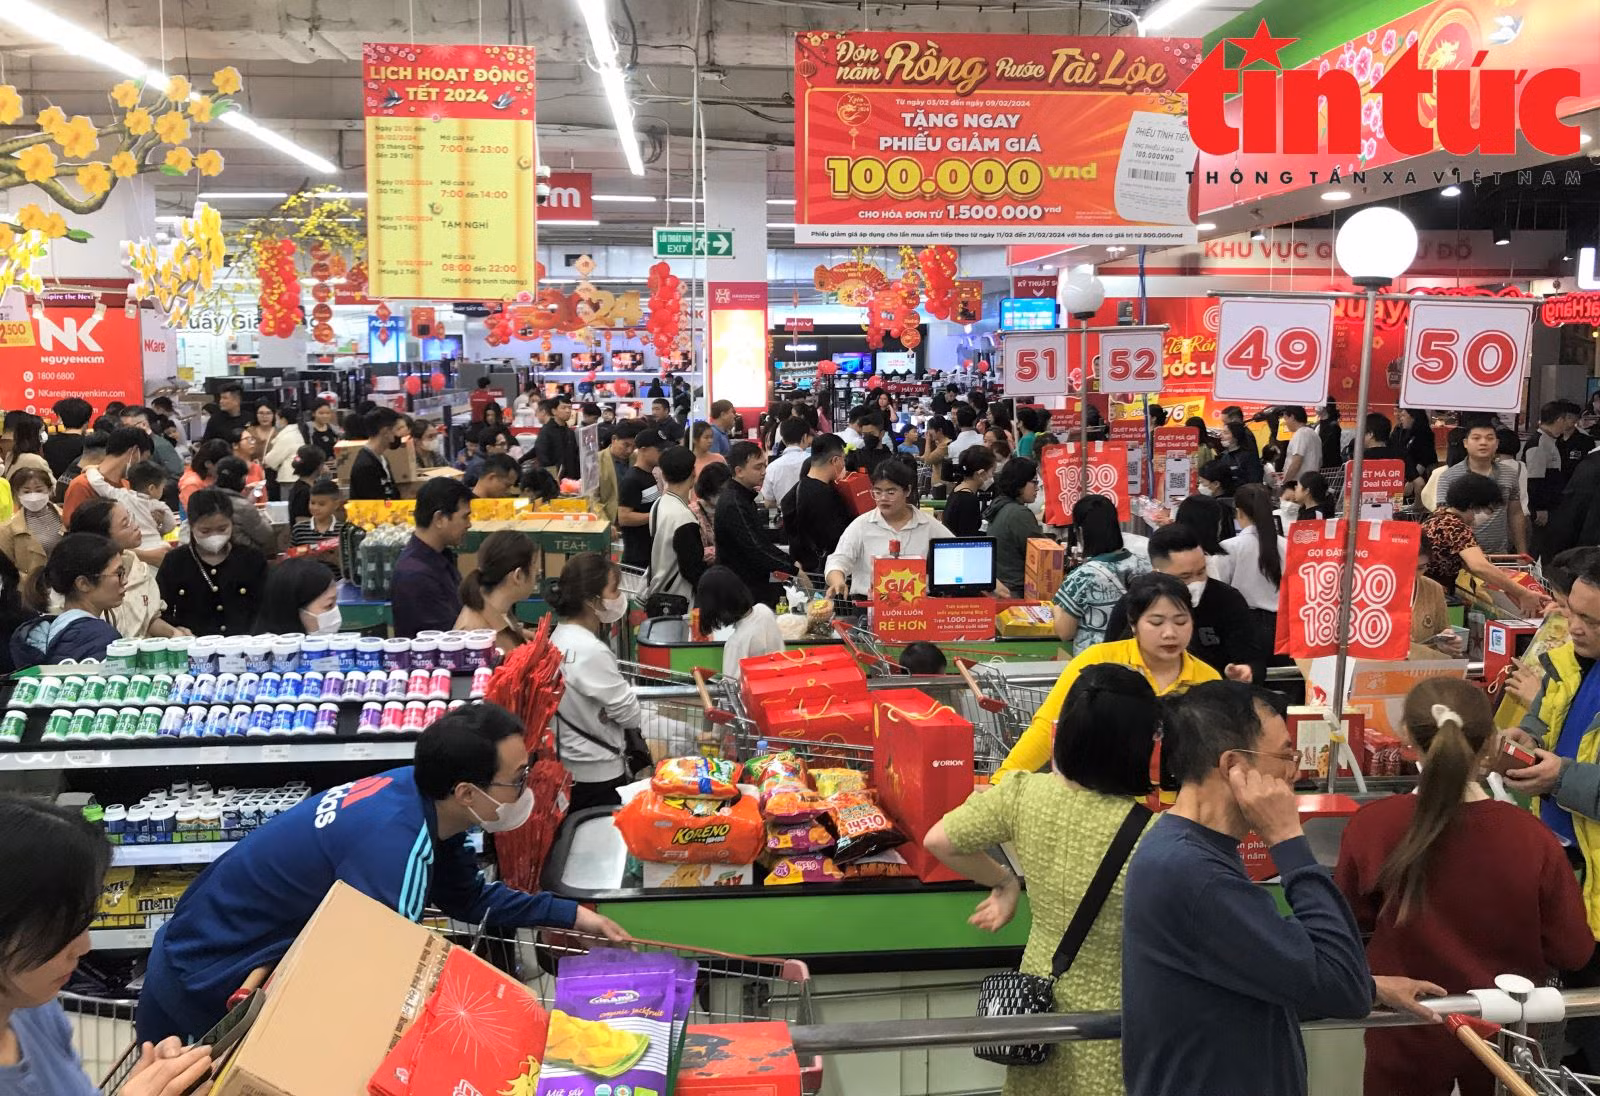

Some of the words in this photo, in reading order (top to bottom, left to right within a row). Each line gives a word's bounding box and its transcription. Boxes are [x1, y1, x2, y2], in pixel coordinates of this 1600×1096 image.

[836, 40, 879, 63] Đón
[370, 66, 412, 82] LỊCH
[418, 68, 470, 84] HOẠT
[473, 66, 528, 86] ĐỘNG
[836, 63, 881, 81] năm
[884, 40, 987, 94] Rồng
[996, 57, 1045, 78] Rước
[1048, 48, 1100, 84] Tài
[1099, 48, 1167, 94] Lộc
[405, 83, 440, 100] TẾT
[444, 89, 488, 102] 2024
[901, 109, 958, 130] TẶNG
[964, 113, 1020, 128] NGAY
[880, 131, 942, 151] PHIẾU
[946, 132, 1000, 151] GIẢM
[1005, 133, 1042, 152] GIÁ
[827, 156, 1044, 199] 100.000
[1048, 162, 1098, 180] vnd
[858, 210, 880, 219] CHO
[881, 208, 903, 219] HÓA
[905, 210, 928, 219] ĐƠN
[929, 209, 944, 219] TỪ
[947, 205, 1043, 220] 1.500.000
[1204, 242, 1252, 258] KHU
[1260, 240, 1308, 262] VỰC
[442, 263, 471, 272] 08:00
[489, 264, 517, 273] 22:00
[1108, 348, 1158, 381] 52
[1222, 325, 1322, 383] 49
[1412, 328, 1518, 388] 50
[1015, 348, 1058, 382] 51
[38, 372, 55, 380] 1800
[56, 372, 75, 380] 6800
[1374, 469, 1387, 478] MÃ
[1307, 549, 1324, 558] GỌI
[898, 620, 927, 630] HƠN
